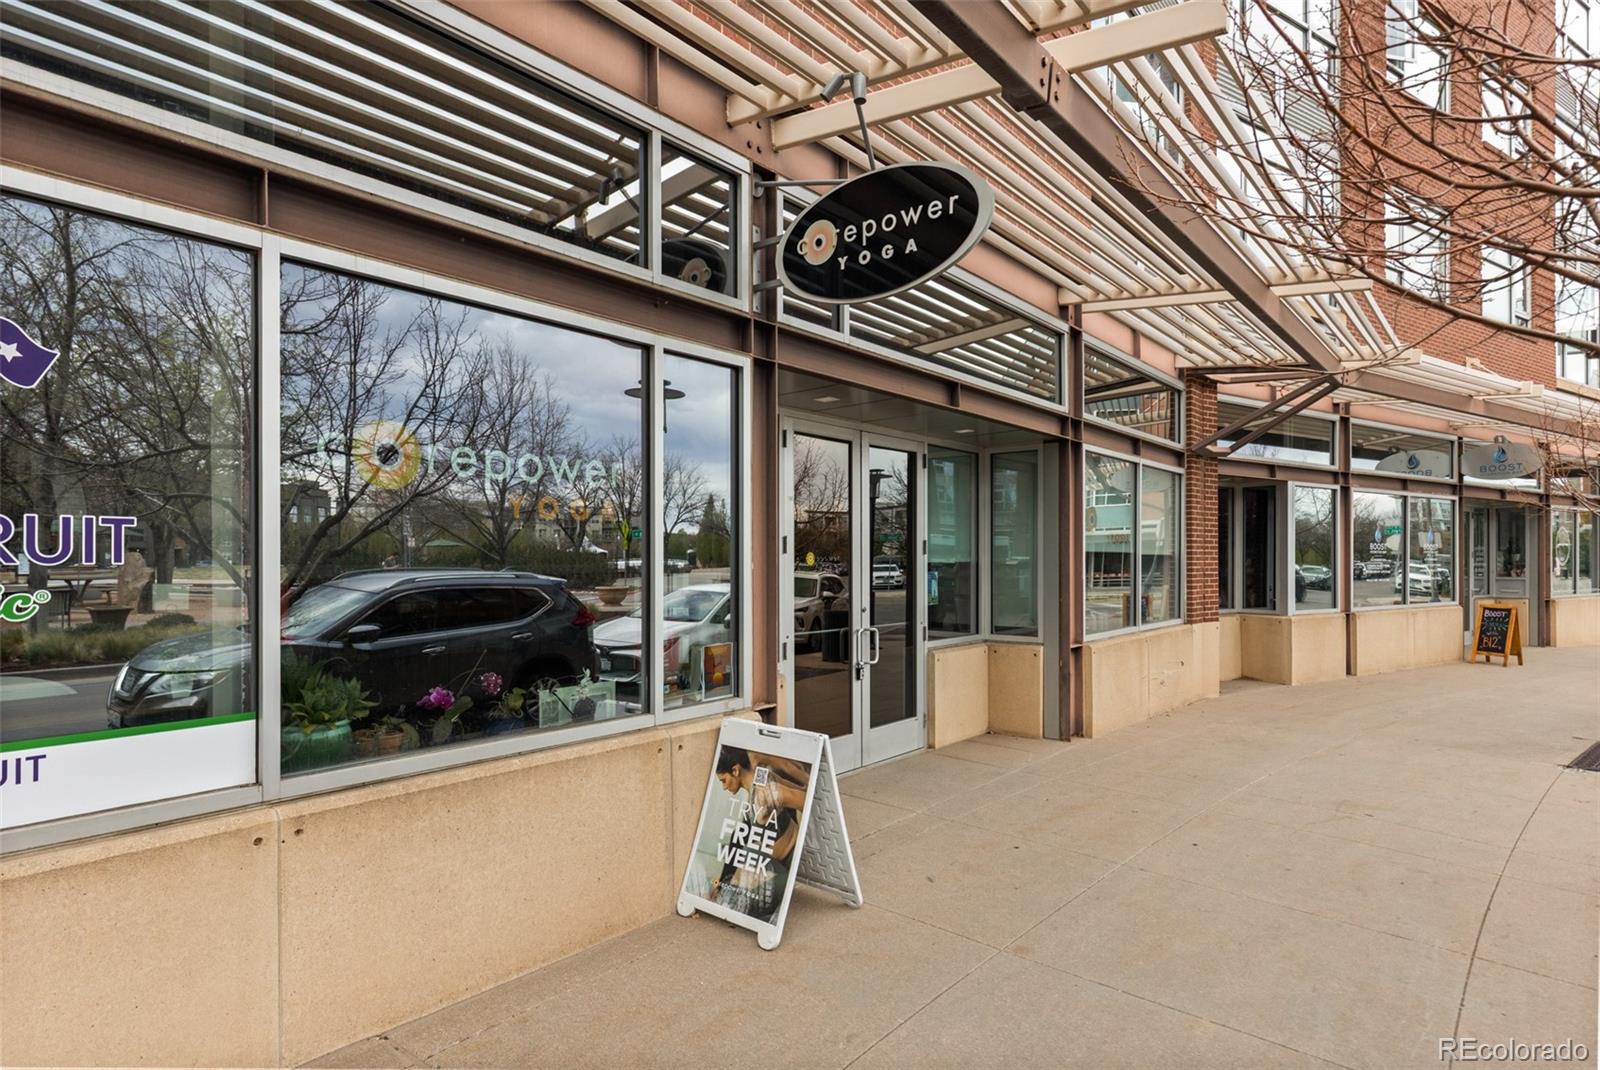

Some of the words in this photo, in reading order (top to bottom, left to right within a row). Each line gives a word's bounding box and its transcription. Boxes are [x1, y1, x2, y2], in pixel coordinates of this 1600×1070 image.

[837, 238, 918, 270] YOGA
[1479, 462, 1522, 474] BOOST
[729, 797, 764, 823] TRY
[765, 809, 778, 830] A
[720, 818, 777, 855] FREE
[717, 842, 771, 877] WEEK
